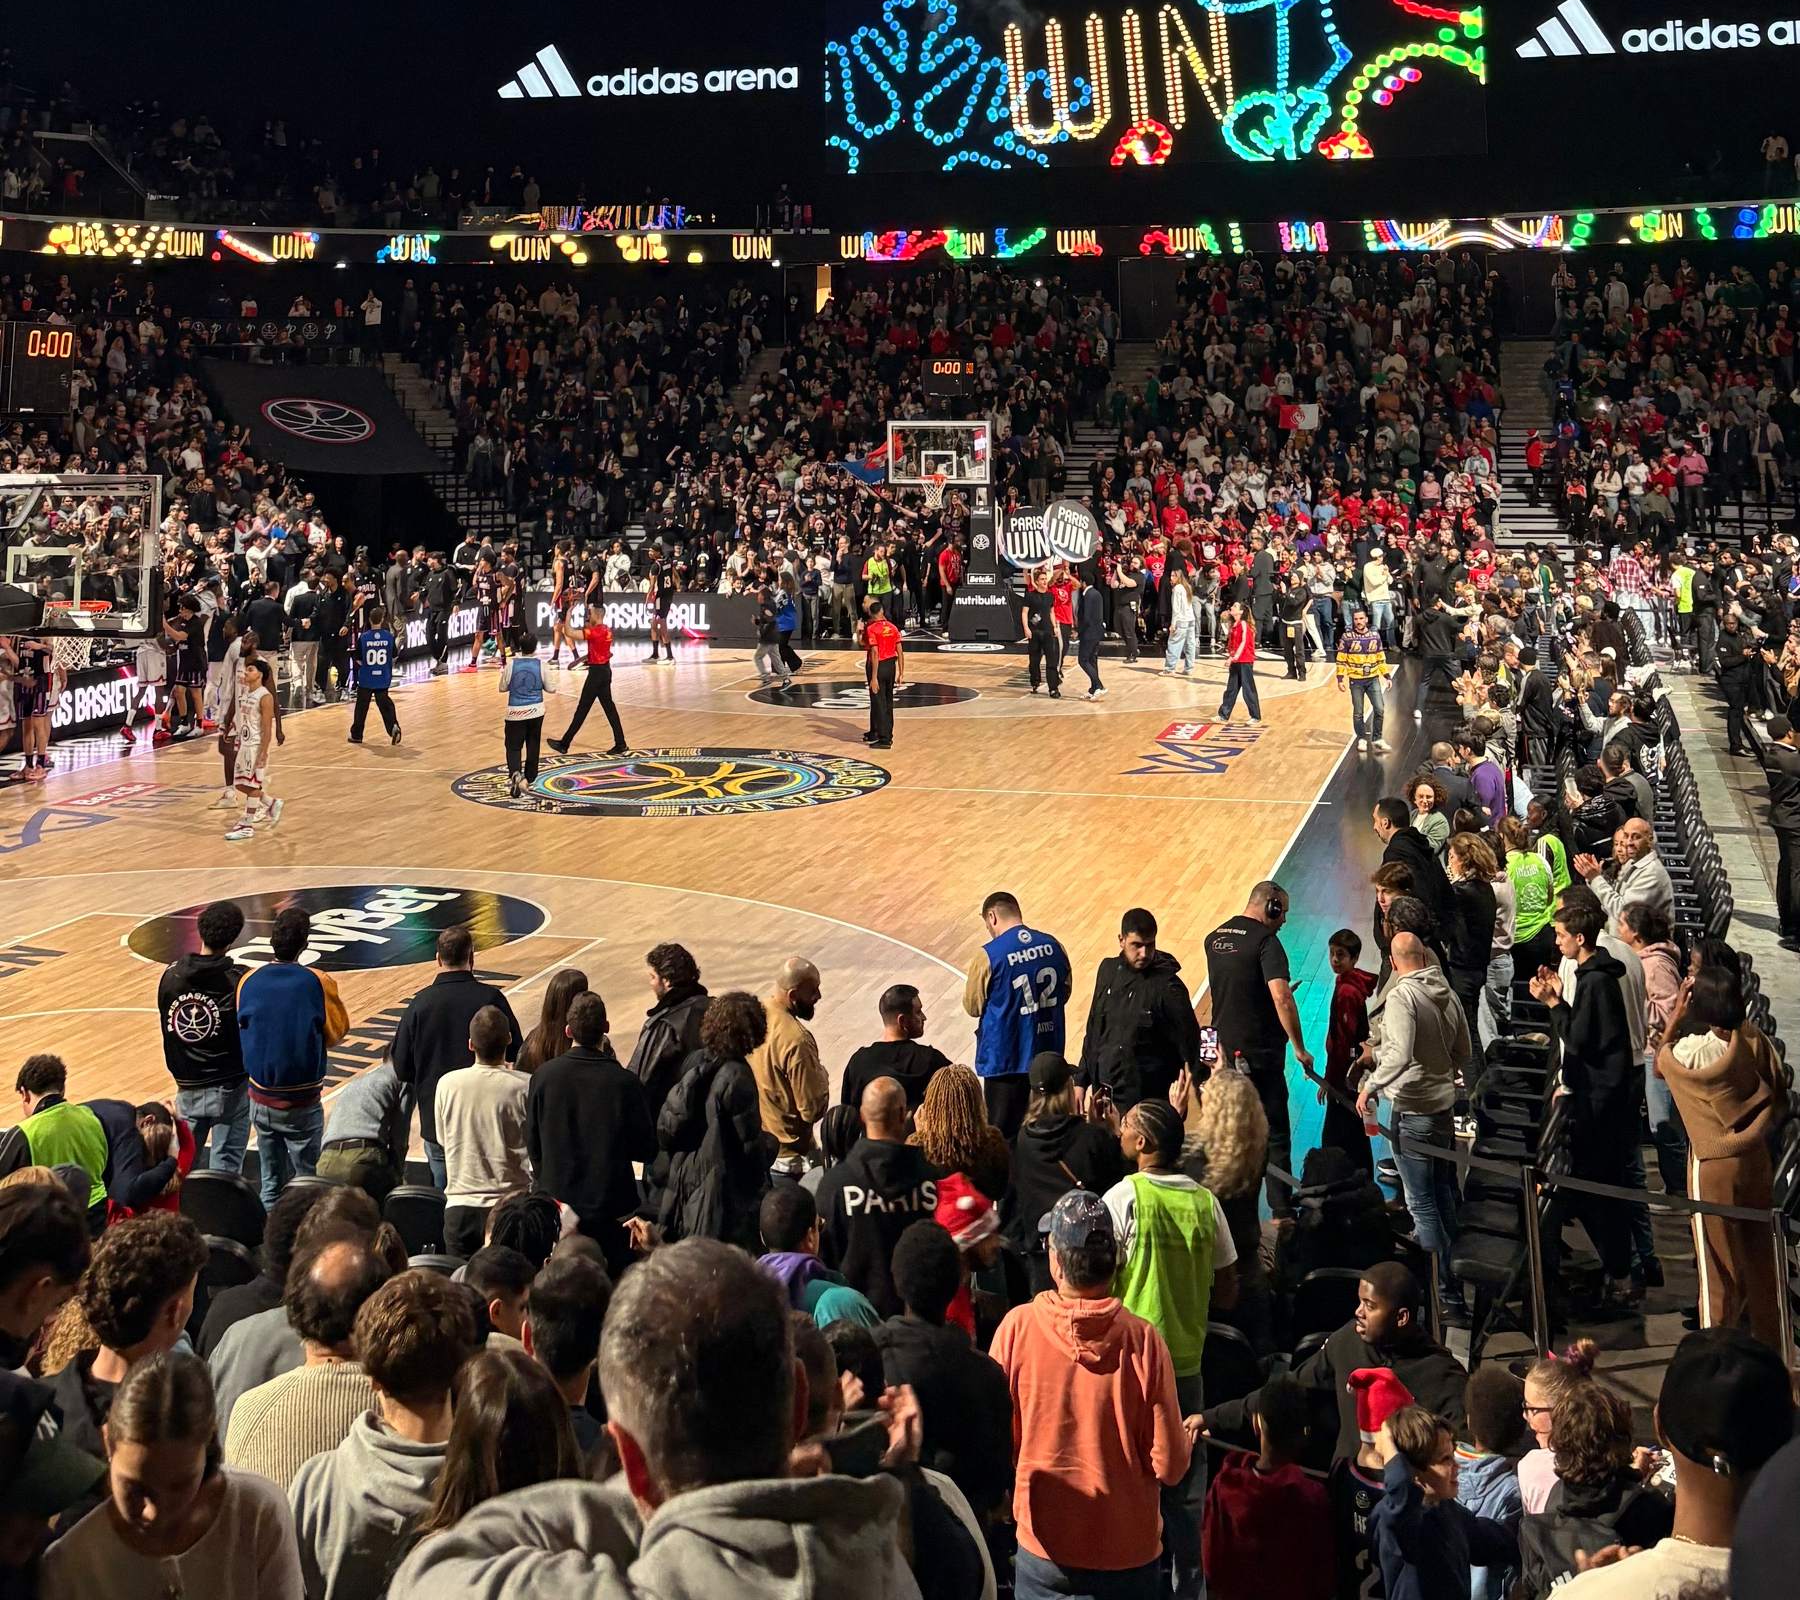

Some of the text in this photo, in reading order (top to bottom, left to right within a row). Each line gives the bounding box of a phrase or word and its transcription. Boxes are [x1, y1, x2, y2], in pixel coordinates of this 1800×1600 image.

[1621, 18, 1761, 53] adidas
[586, 66, 799, 97] adidas arena
[168, 231, 204, 257] WIN
[272, 234, 314, 259] WIN
[390, 236, 430, 262] WIN
[509, 236, 551, 262] WIN
[732, 236, 772, 260] WIN
[1056, 229, 1097, 254] WIN
[27, 329, 73, 358] 0:00
[933, 361, 961, 375] 0:00
[1009, 515, 1044, 532] PARIS
[1057, 506, 1090, 531] PARIS
[1006, 530, 1051, 560] WIN
[1050, 517, 1092, 558] WIN
[969, 575, 994, 584] Betclic
[366, 649, 387, 666] 06
[1006, 943, 1054, 967] PHOTO
[1011, 966, 1058, 1016] 12
[166, 991, 222, 1038] PARIS BASKETBALL
